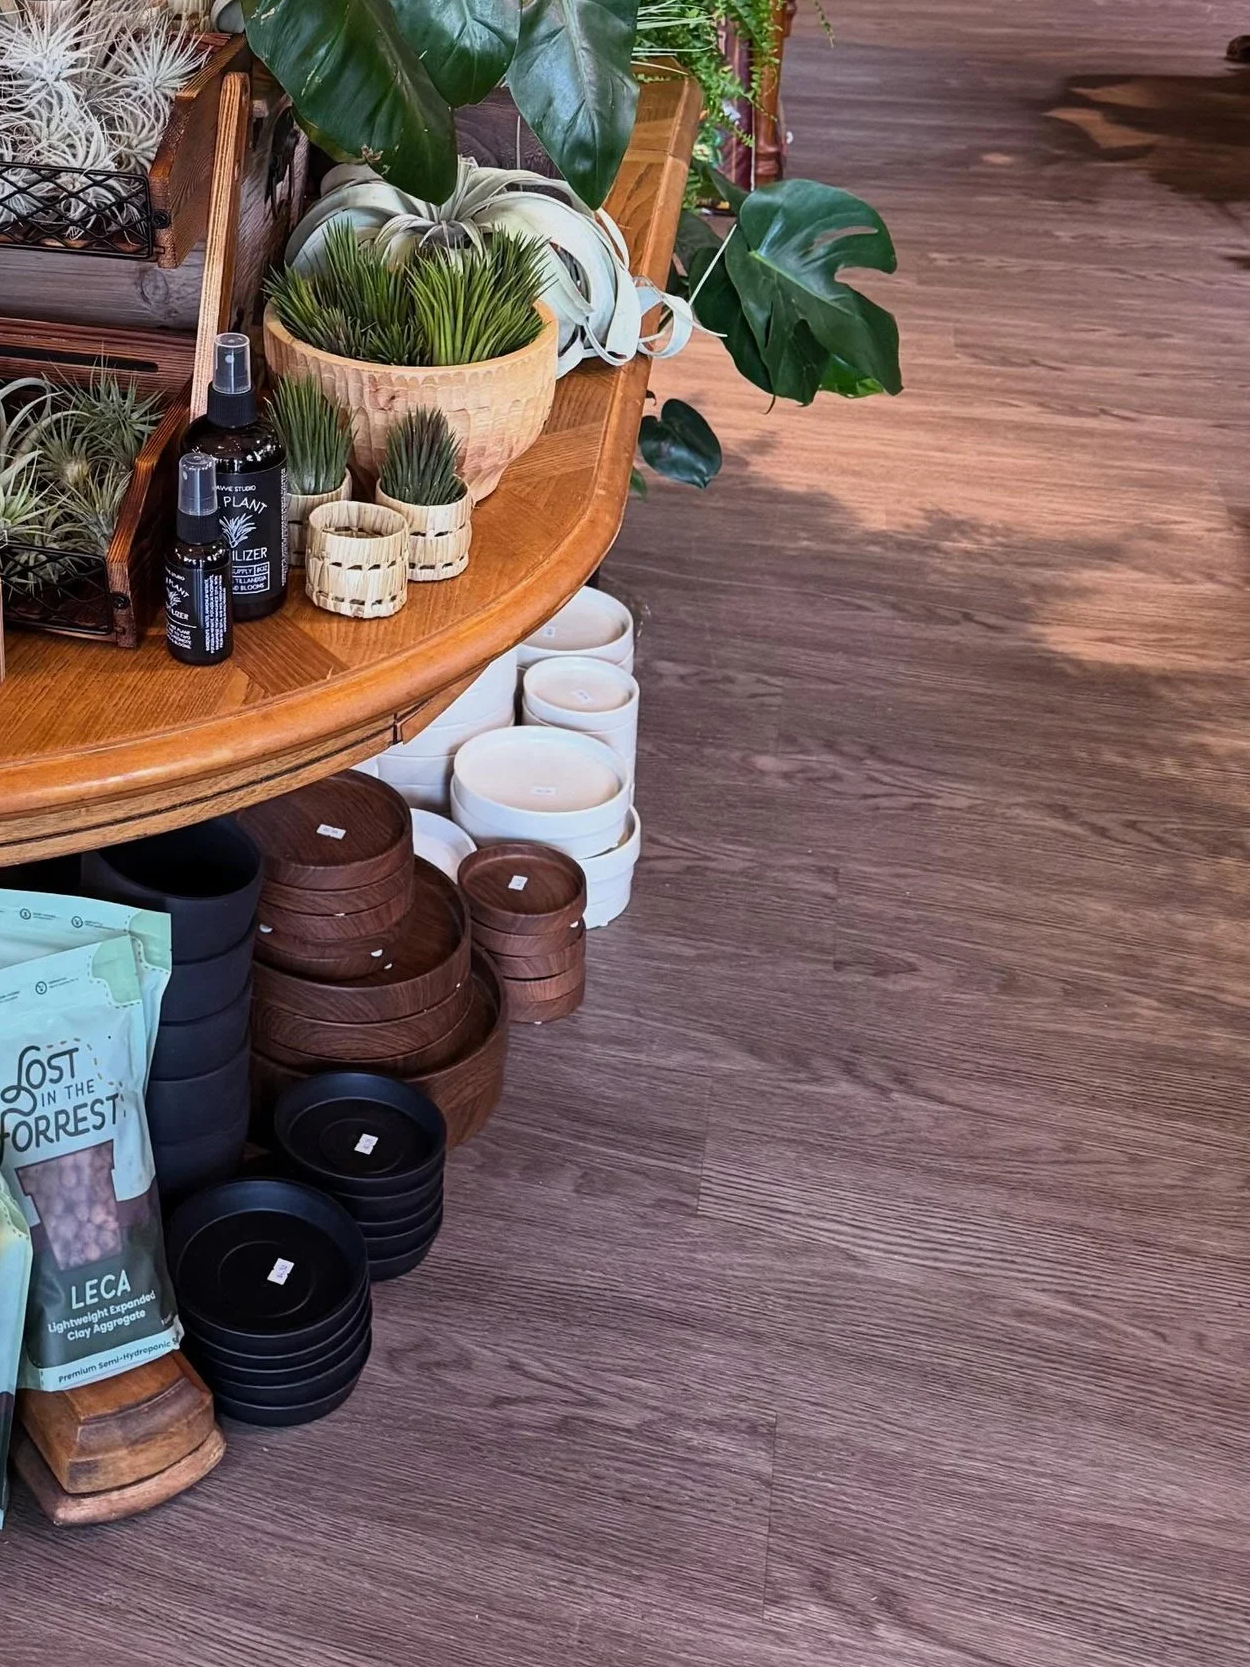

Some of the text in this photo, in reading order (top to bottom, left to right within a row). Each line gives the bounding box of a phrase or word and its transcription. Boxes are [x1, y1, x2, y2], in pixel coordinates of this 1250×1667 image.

[223, 496, 267, 514] PLANT
[232, 547, 268, 562] ILIZER
[0, 1045, 80, 1117] LOST
[40, 1079, 95, 1108] IN THE
[71, 1269, 131, 1310] LECA
[48, 1290, 156, 1334] Lightweight Expanded
[67, 1326, 91, 1341] Clay
[93, 1309, 146, 1335] Aggregate
[58, 1340, 171, 1383] Premium Semi-Hydroponic
